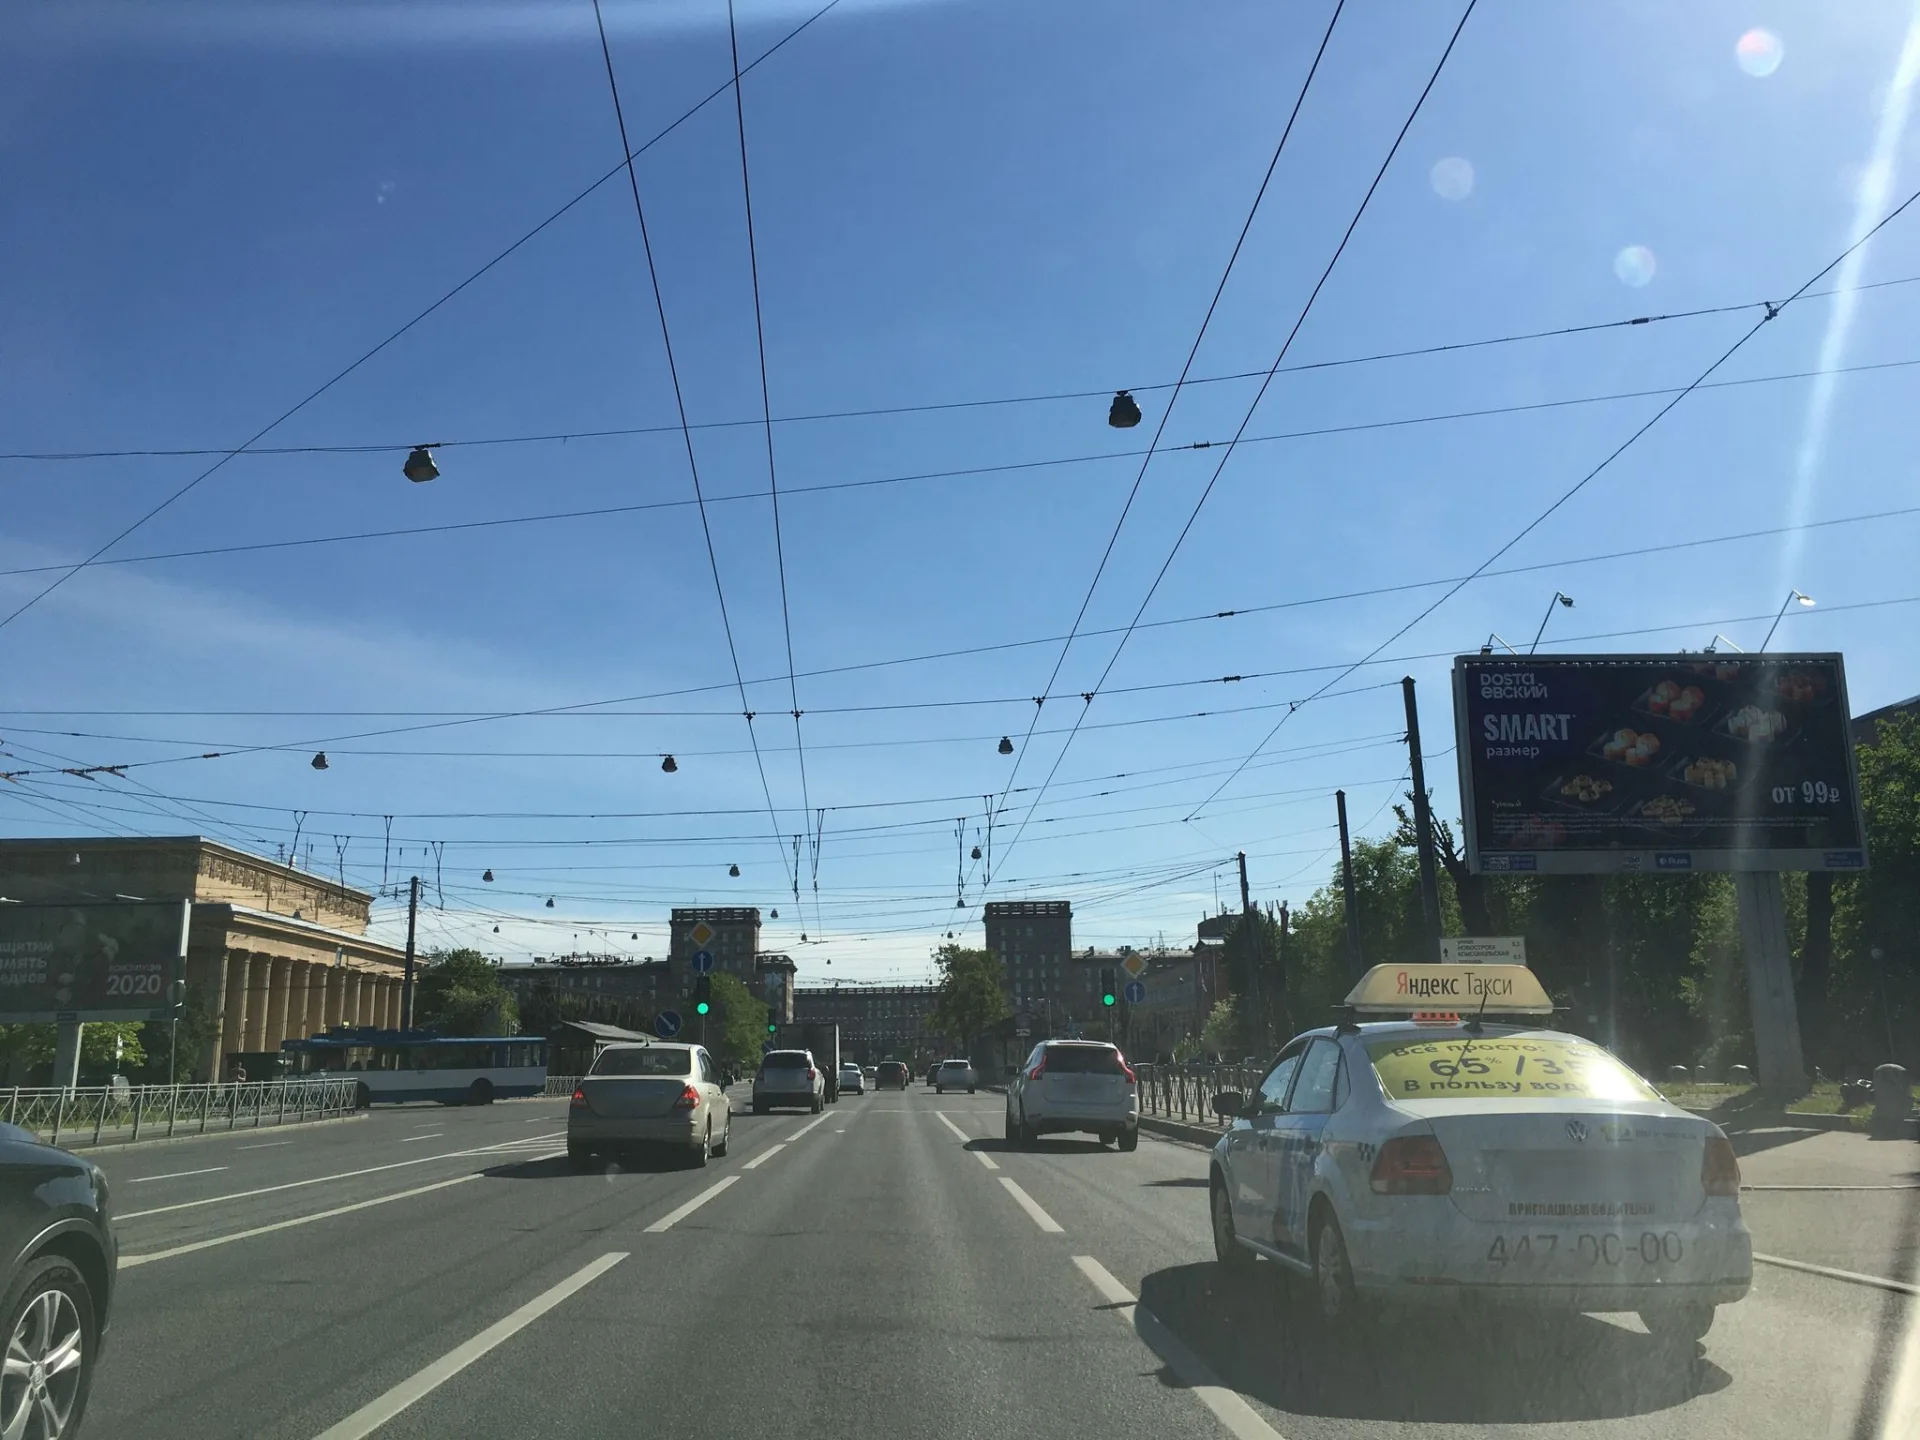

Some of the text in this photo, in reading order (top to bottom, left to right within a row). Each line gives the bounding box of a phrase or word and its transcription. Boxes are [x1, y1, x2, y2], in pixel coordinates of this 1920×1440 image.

[1486, 745, 1540, 759] размер
[0, 941, 54, 956] щитим
[0, 971, 47, 986] едков
[106, 974, 162, 995] 2020
[1397, 971, 1513, 998] Яндекс Такси
[1392, 1042, 1439, 1057] Всё
[1446, 1042, 1546, 1054] просто:
[1404, 1080, 1421, 1092] В
[1430, 1080, 1522, 1093] пользу
